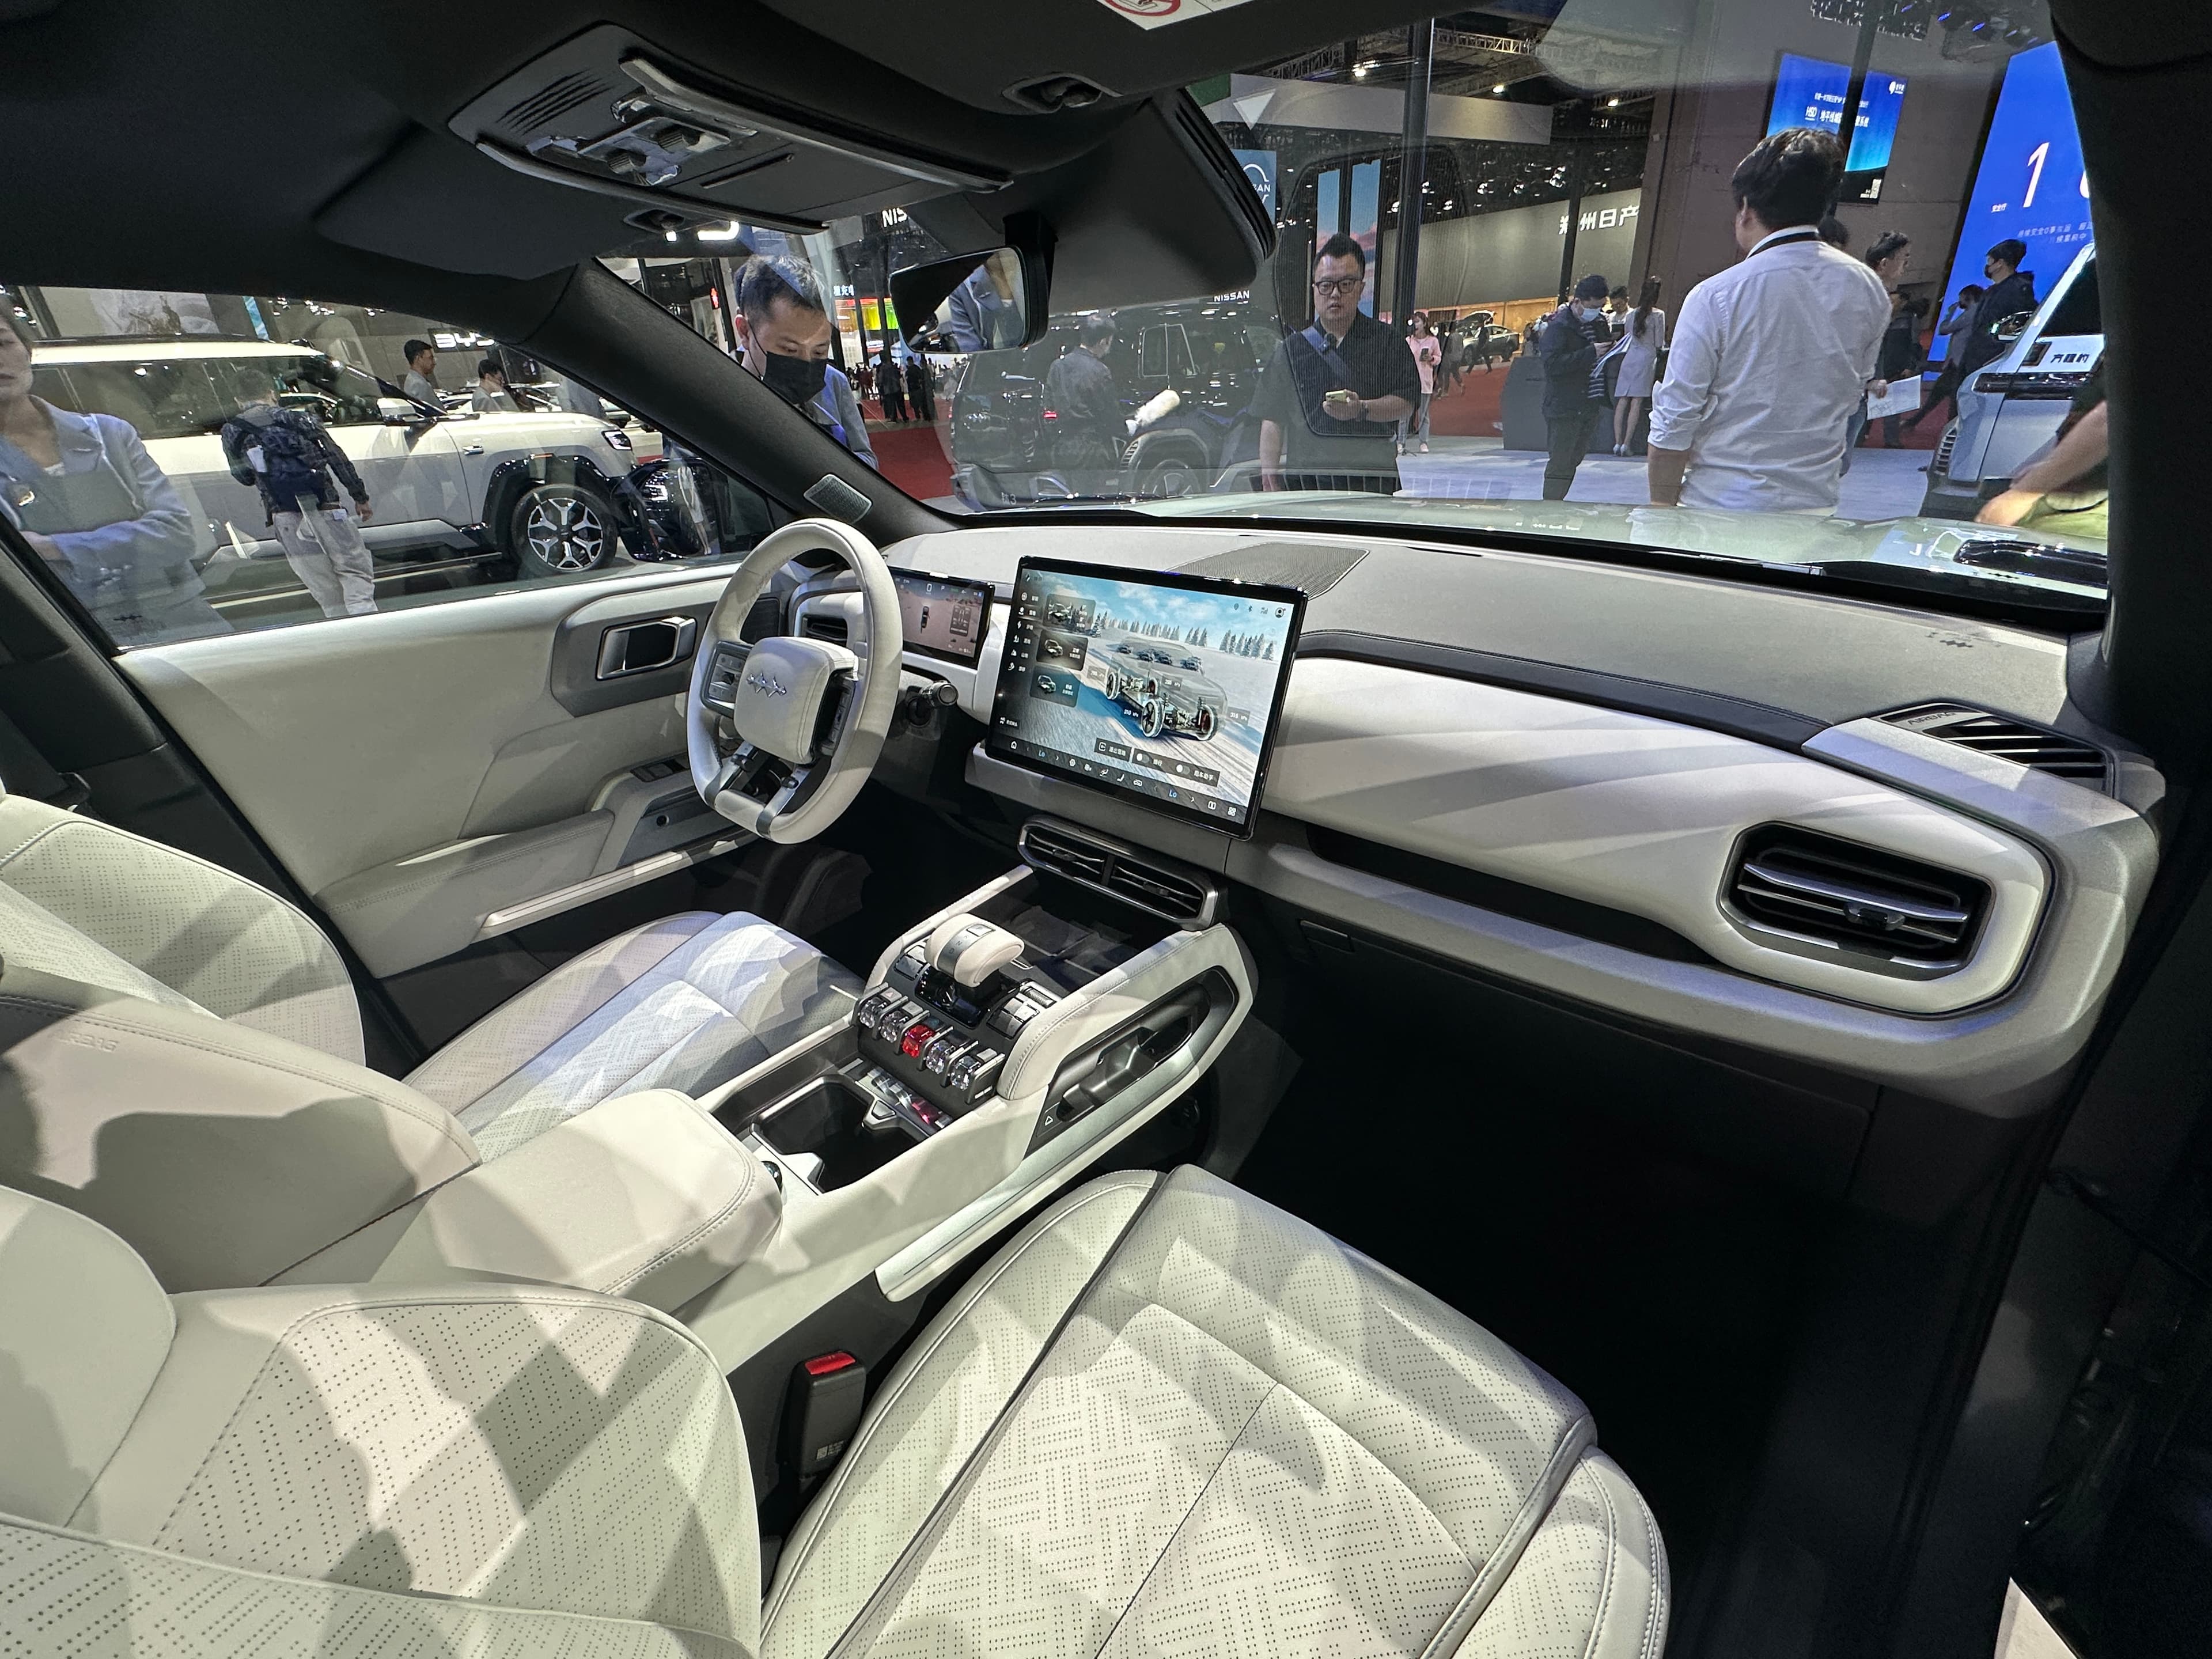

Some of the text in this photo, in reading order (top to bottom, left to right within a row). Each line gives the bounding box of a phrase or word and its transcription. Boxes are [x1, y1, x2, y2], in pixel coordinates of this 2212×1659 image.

[1214, 290, 1250, 302] NISSAN
[1907, 711, 1956, 725] AIRBAG
[1169, 789, 1177, 798] Lo
